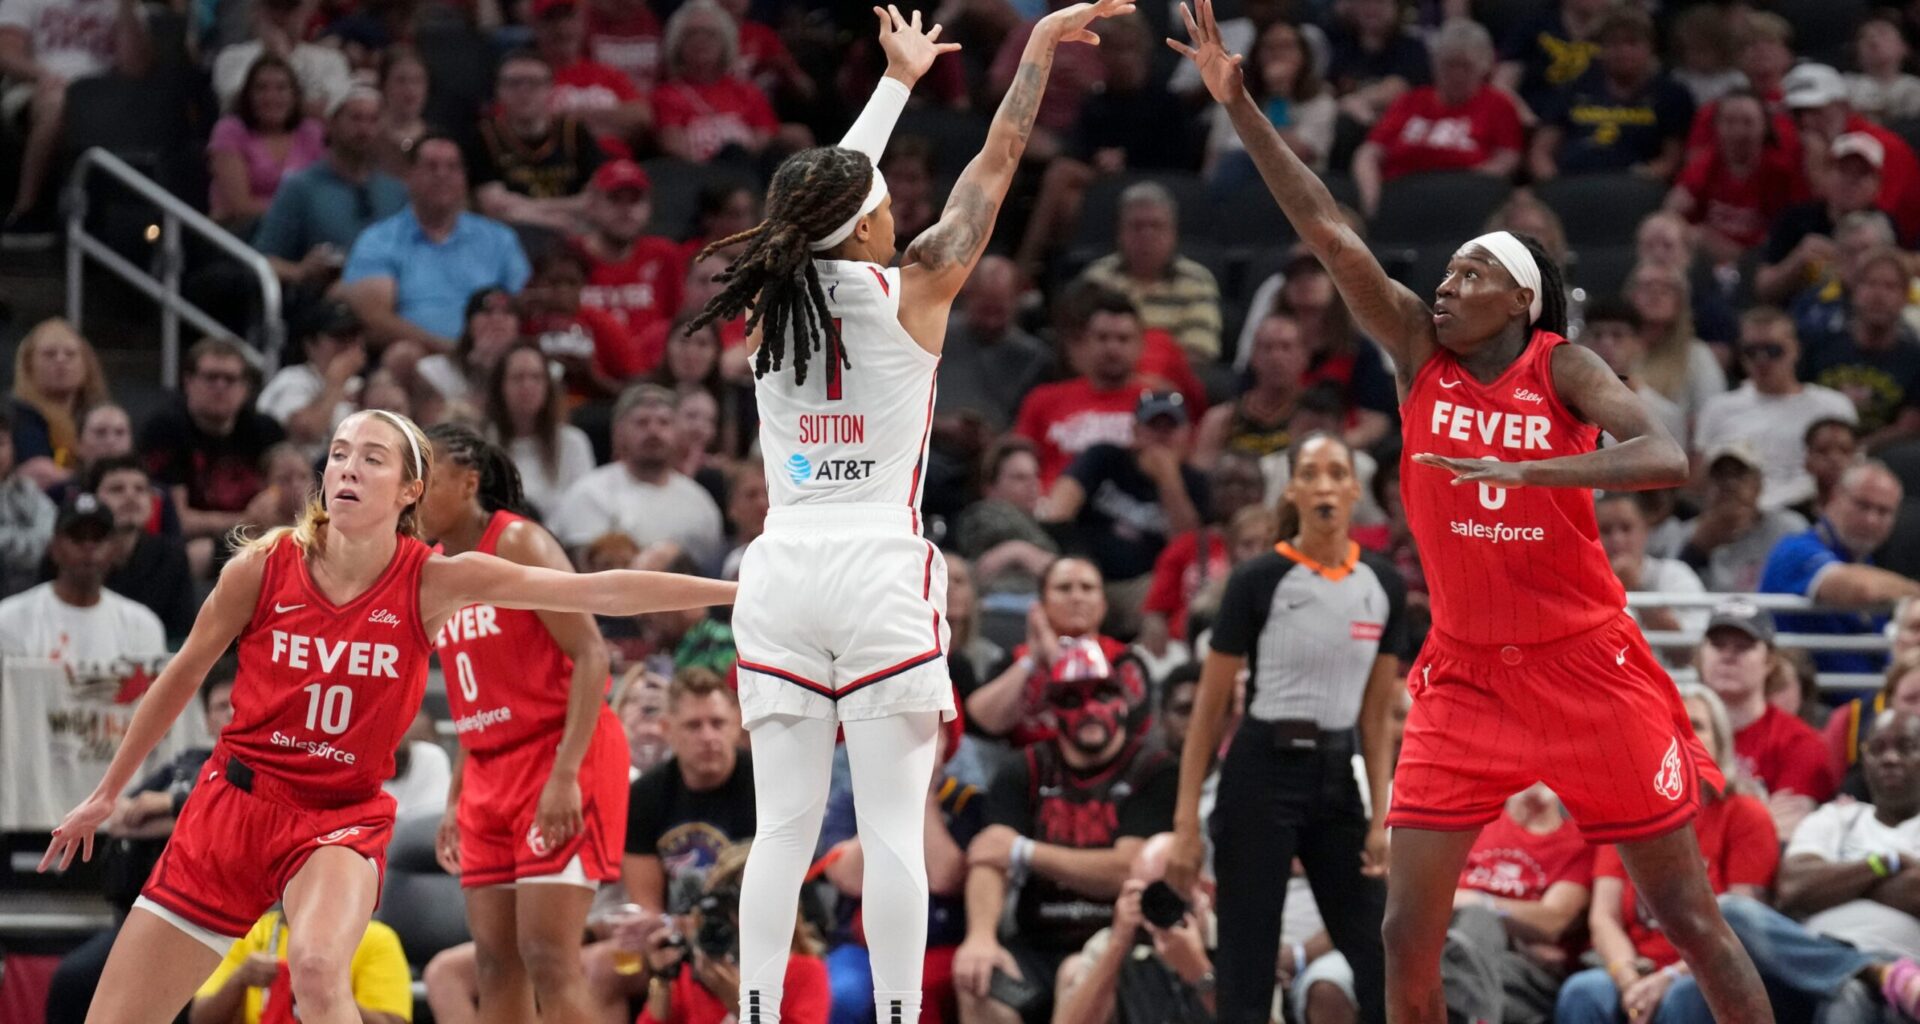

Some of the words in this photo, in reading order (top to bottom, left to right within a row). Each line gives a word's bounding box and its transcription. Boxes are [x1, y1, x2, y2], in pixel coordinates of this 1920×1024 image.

[1513, 387, 1544, 406] Lilly
[799, 414, 864, 444] SUTTON
[1431, 399, 1553, 450] FEVER
[815, 460, 876, 481] AT&T
[1450, 518, 1545, 544] salesforce
[368, 609, 401, 629] Lilly
[437, 605, 502, 648] EVER
[271, 629, 400, 679] FEVER
[456, 651, 478, 702] 0
[303, 683, 353, 735] 10
[455, 706, 512, 734] alesforce
[270, 730, 356, 765] salesforce
